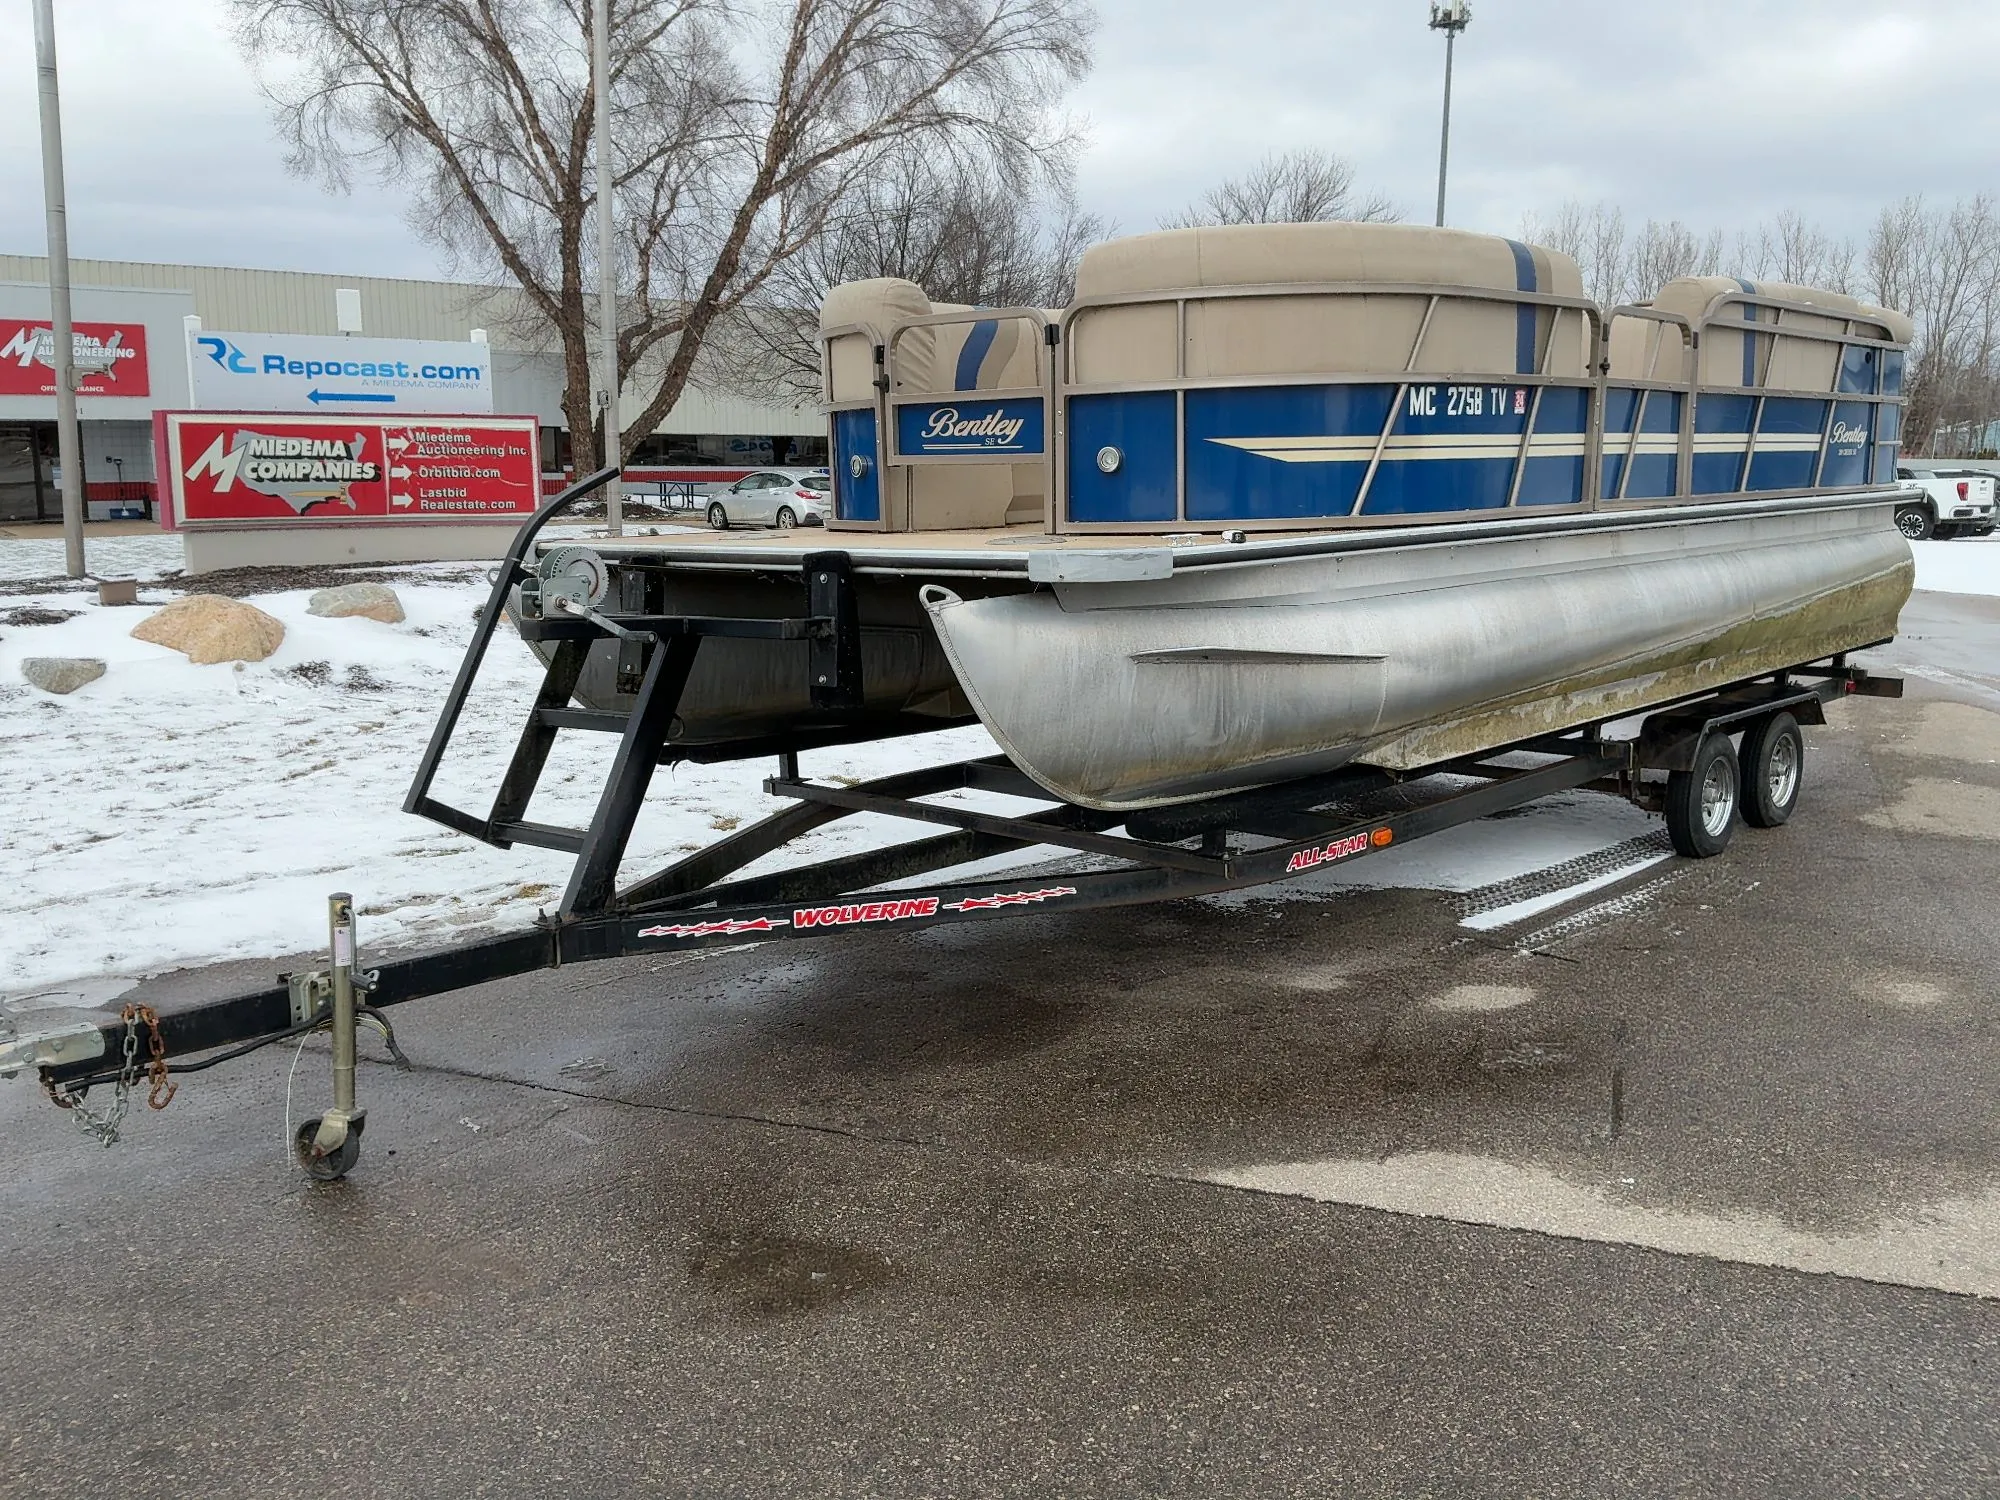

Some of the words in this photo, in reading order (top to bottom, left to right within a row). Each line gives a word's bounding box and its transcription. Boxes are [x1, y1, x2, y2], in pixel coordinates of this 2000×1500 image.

[41, 335, 102, 347] MEMA
[37, 345, 136, 359] AUONEERING
[263, 354, 481, 379] Repocast.com
[372, 380, 425, 388] MIEDEMA
[428, 381, 481, 390] COMPANY
[1409, 386, 1437, 416] MC
[1447, 386, 1483, 416] 2758
[1490, 387, 1507, 415] TV
[921, 407, 1025, 444] Bentley
[415, 432, 472, 443] Miedema
[984, 437, 995, 445] SE
[1830, 421, 1868, 448] Bentley
[250, 438, 349, 459] MIEDEMA
[417, 444, 505, 457] Auctioneering
[244, 461, 377, 481] COMPANIES
[419, 467, 501, 478] Orbitbid.com
[420, 488, 467, 498] Lastbid
[420, 500, 516, 510] Realestate.com
[1286, 832, 1368, 873] ALL-STAR
[793, 896, 940, 929] WOLVERINE
